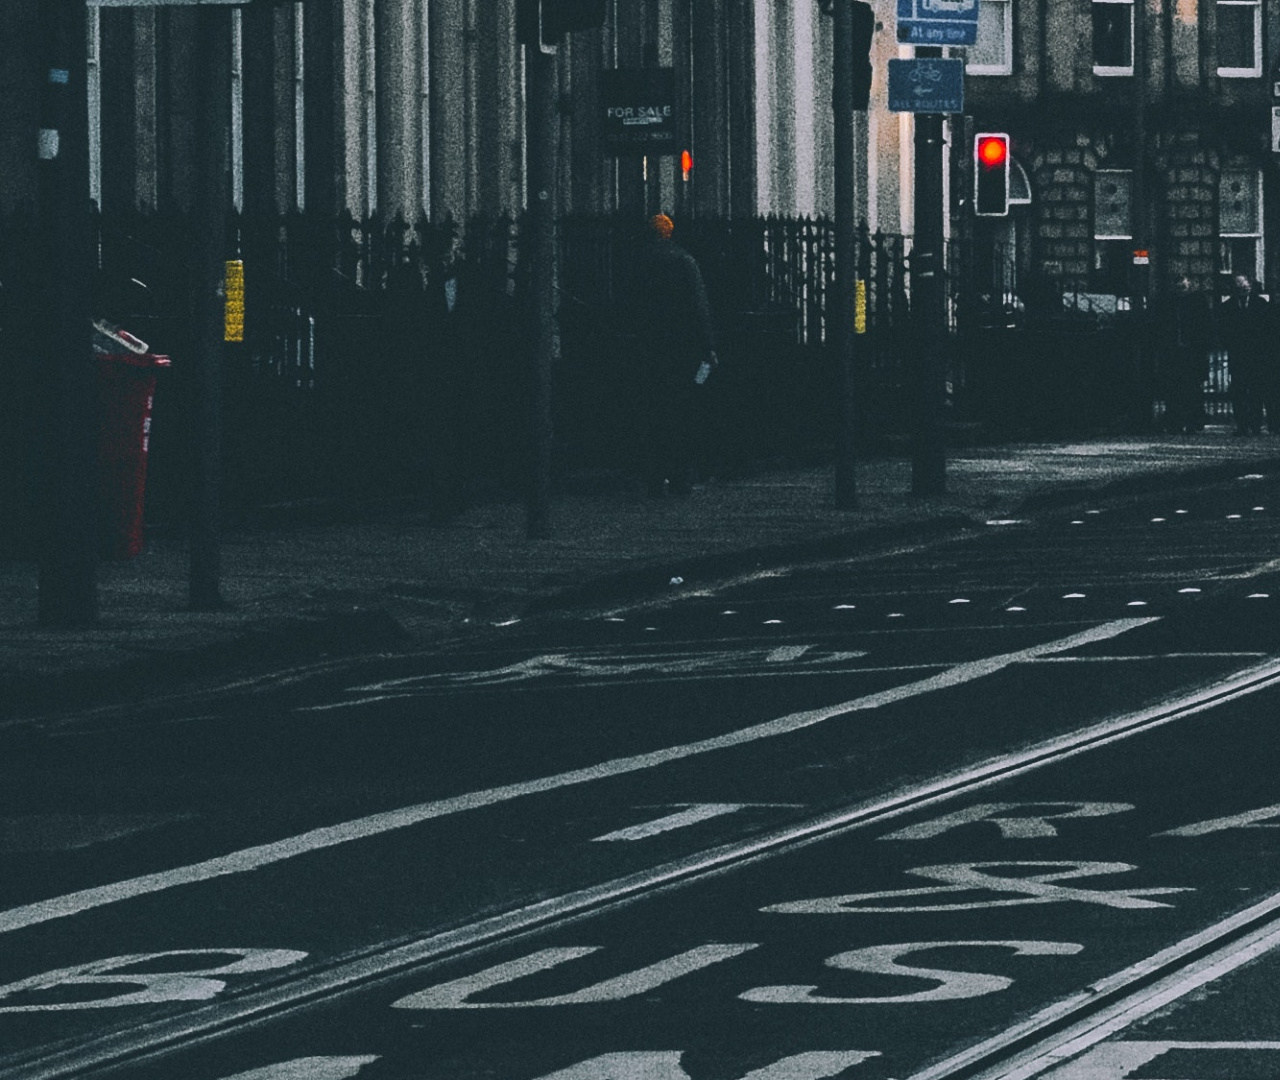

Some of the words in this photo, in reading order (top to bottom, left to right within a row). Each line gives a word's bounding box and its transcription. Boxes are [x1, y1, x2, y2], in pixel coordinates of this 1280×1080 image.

[910, 26, 924, 38] At
[926, 27, 944, 41] any
[607, 106, 635, 118] FOR
[637, 104, 672, 118] SALE
[893, 99, 911, 110] ALL
[914, 99, 958, 110] ROUTES
[759, 860, 1197, 915] &
[0, 938, 1085, 1012] BUS
